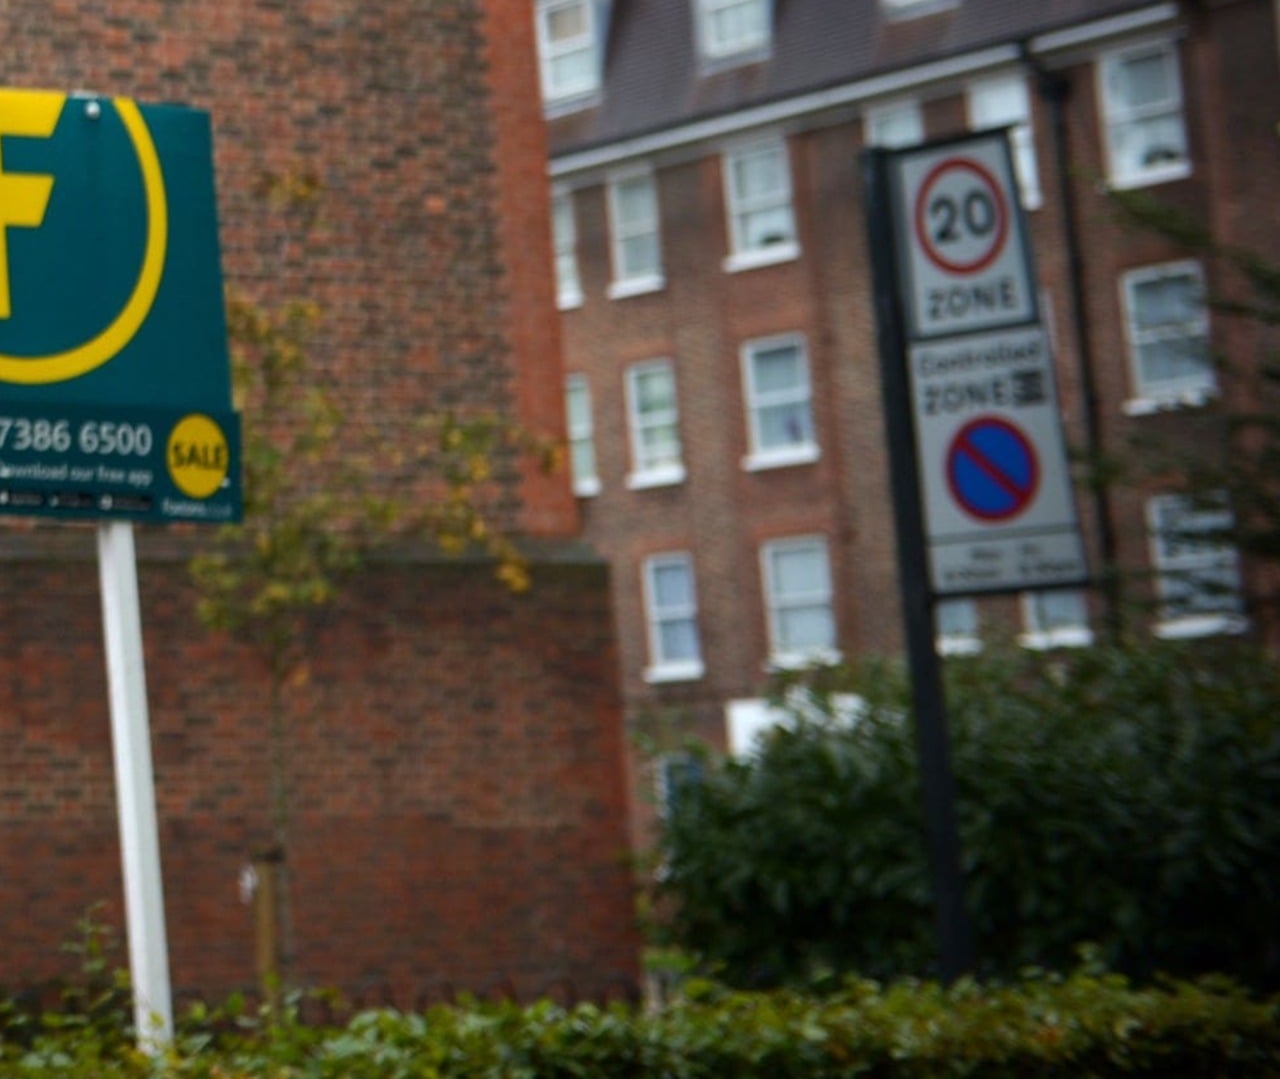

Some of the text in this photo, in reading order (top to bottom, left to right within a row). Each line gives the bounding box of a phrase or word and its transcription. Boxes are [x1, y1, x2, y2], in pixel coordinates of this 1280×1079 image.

[930, 189, 996, 241] 20
[928, 277, 1018, 318] ZONE
[925, 376, 1007, 415] ZONE
[78, 422, 153, 456] 6500
[173, 441, 225, 471] SALE
